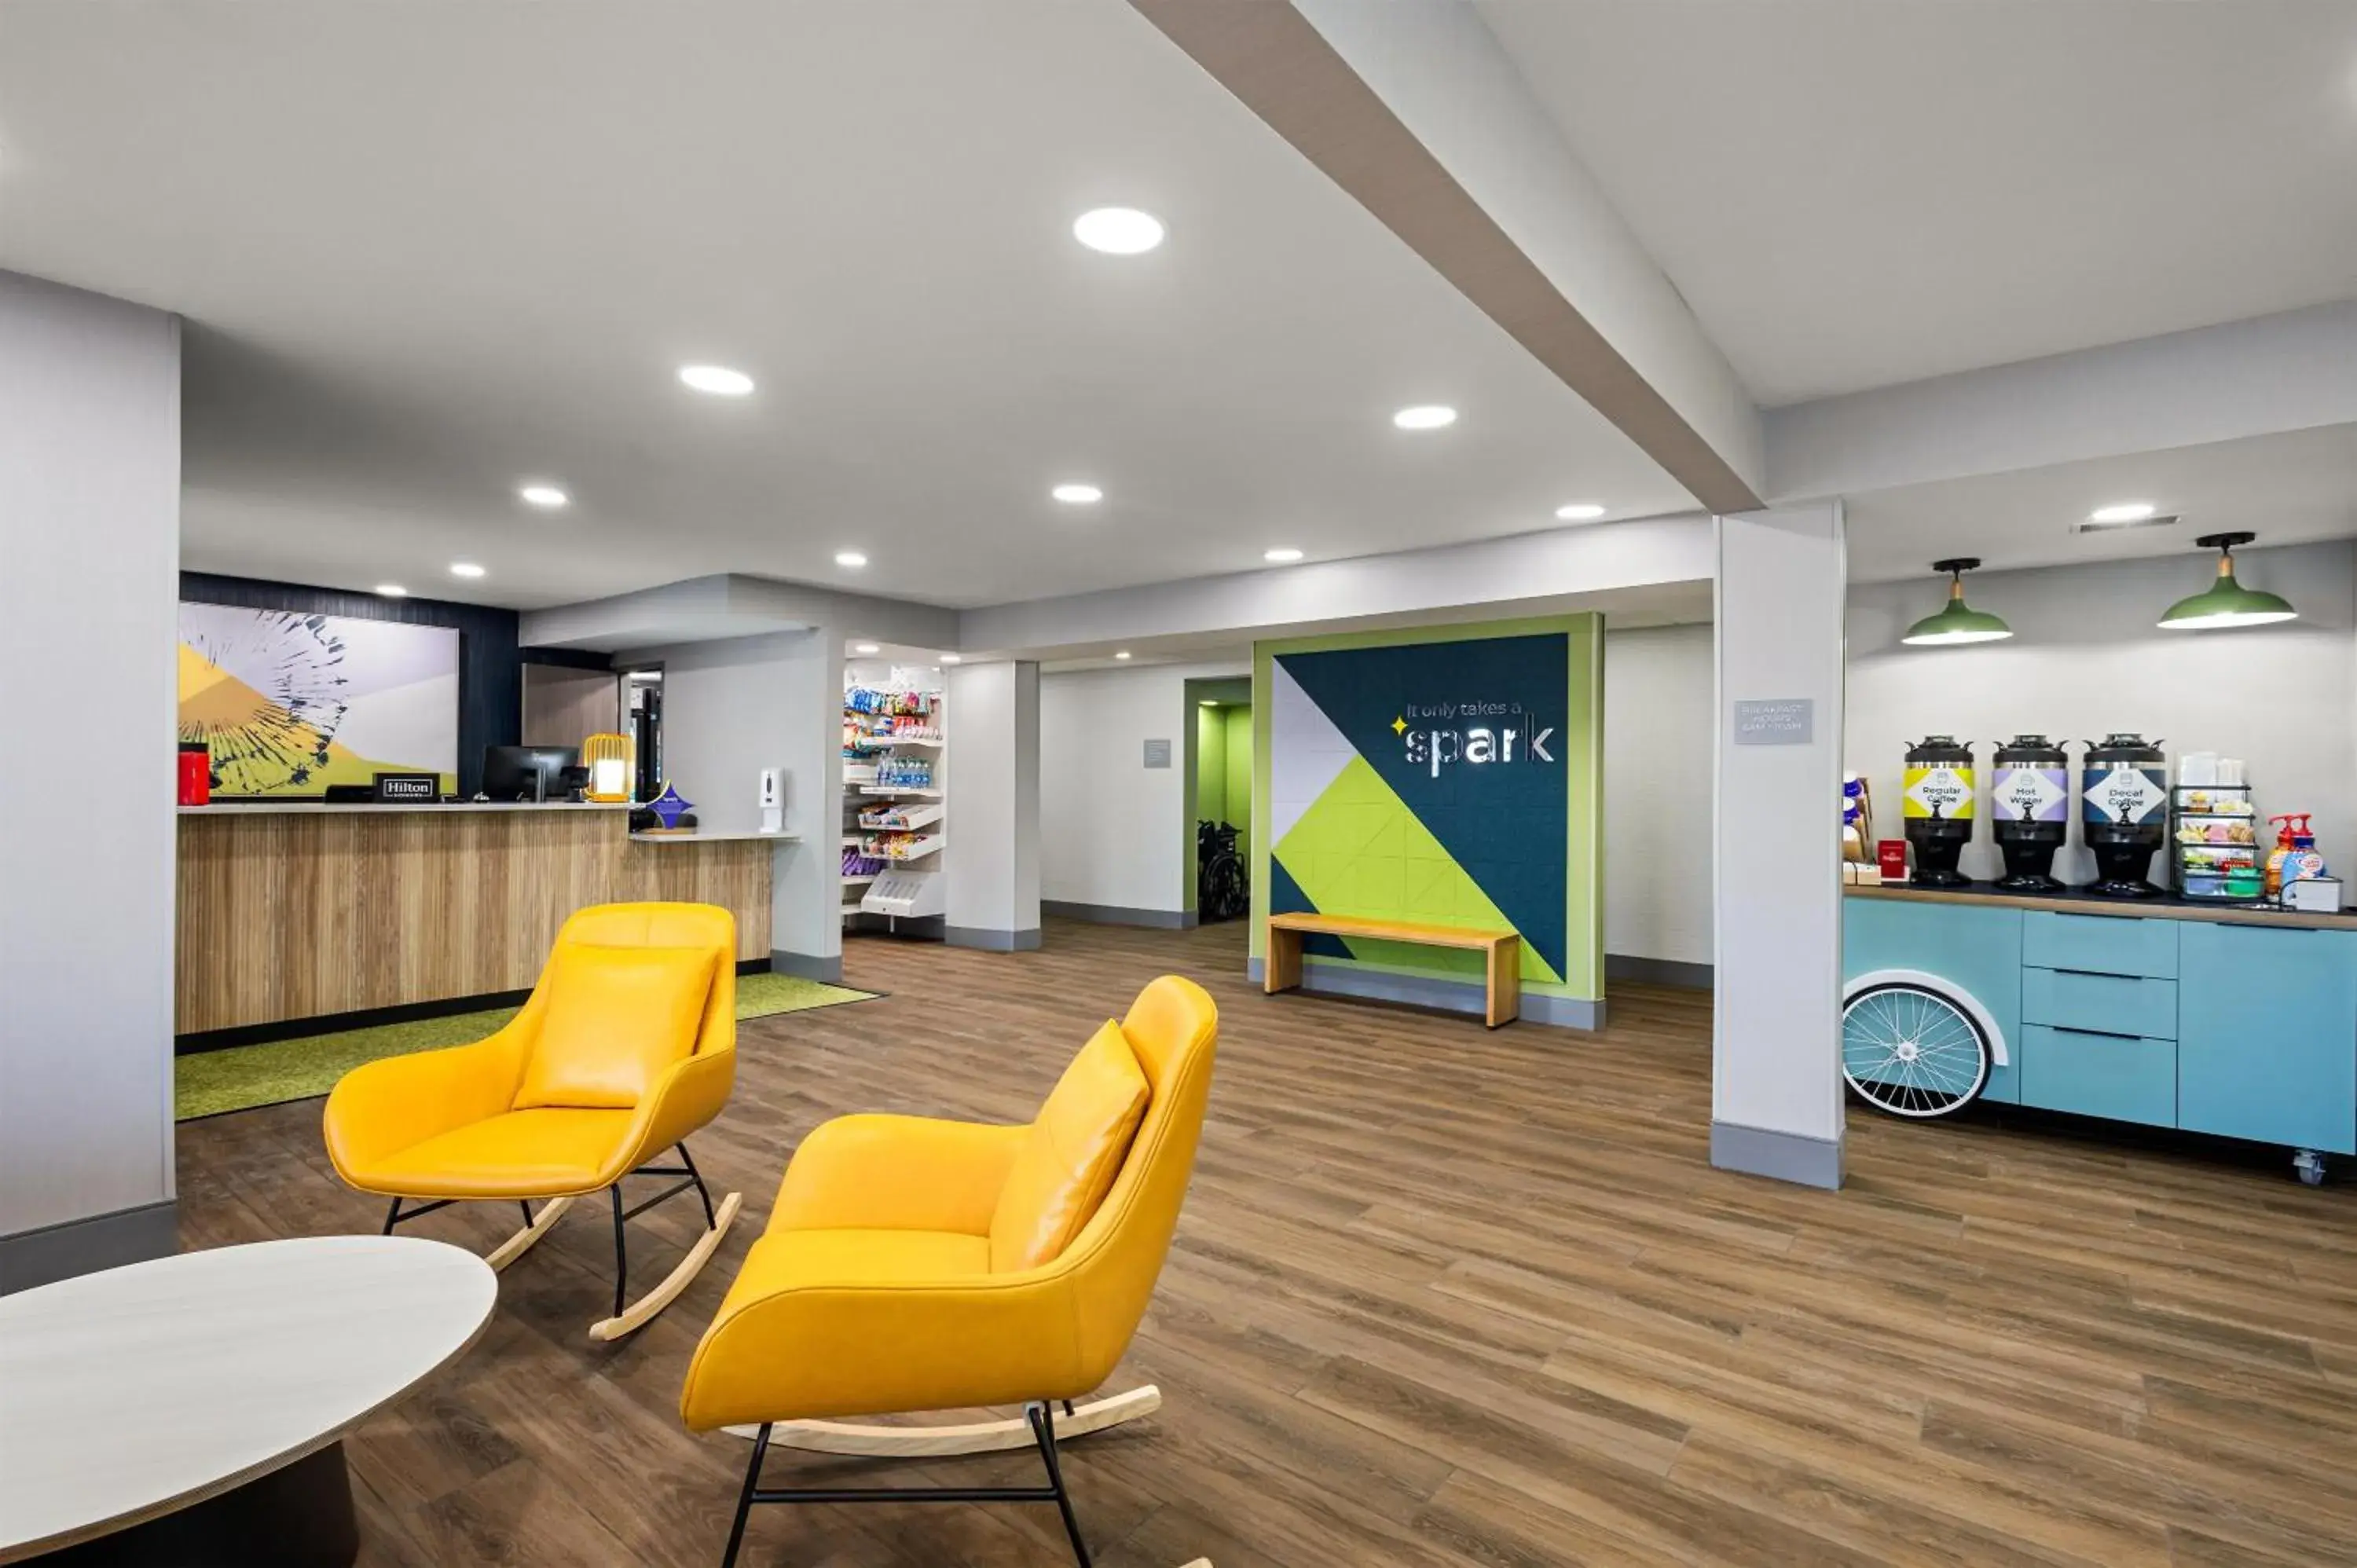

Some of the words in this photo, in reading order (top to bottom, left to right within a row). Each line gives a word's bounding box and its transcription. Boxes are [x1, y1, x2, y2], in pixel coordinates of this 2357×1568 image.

[1421, 701, 1457, 720] only
[1461, 699, 1507, 716] takes
[1511, 702, 1522, 714] a
[1405, 713, 1555, 778] spark
[388, 782, 428, 793] Hilton
[1923, 786, 1961, 795] Regular
